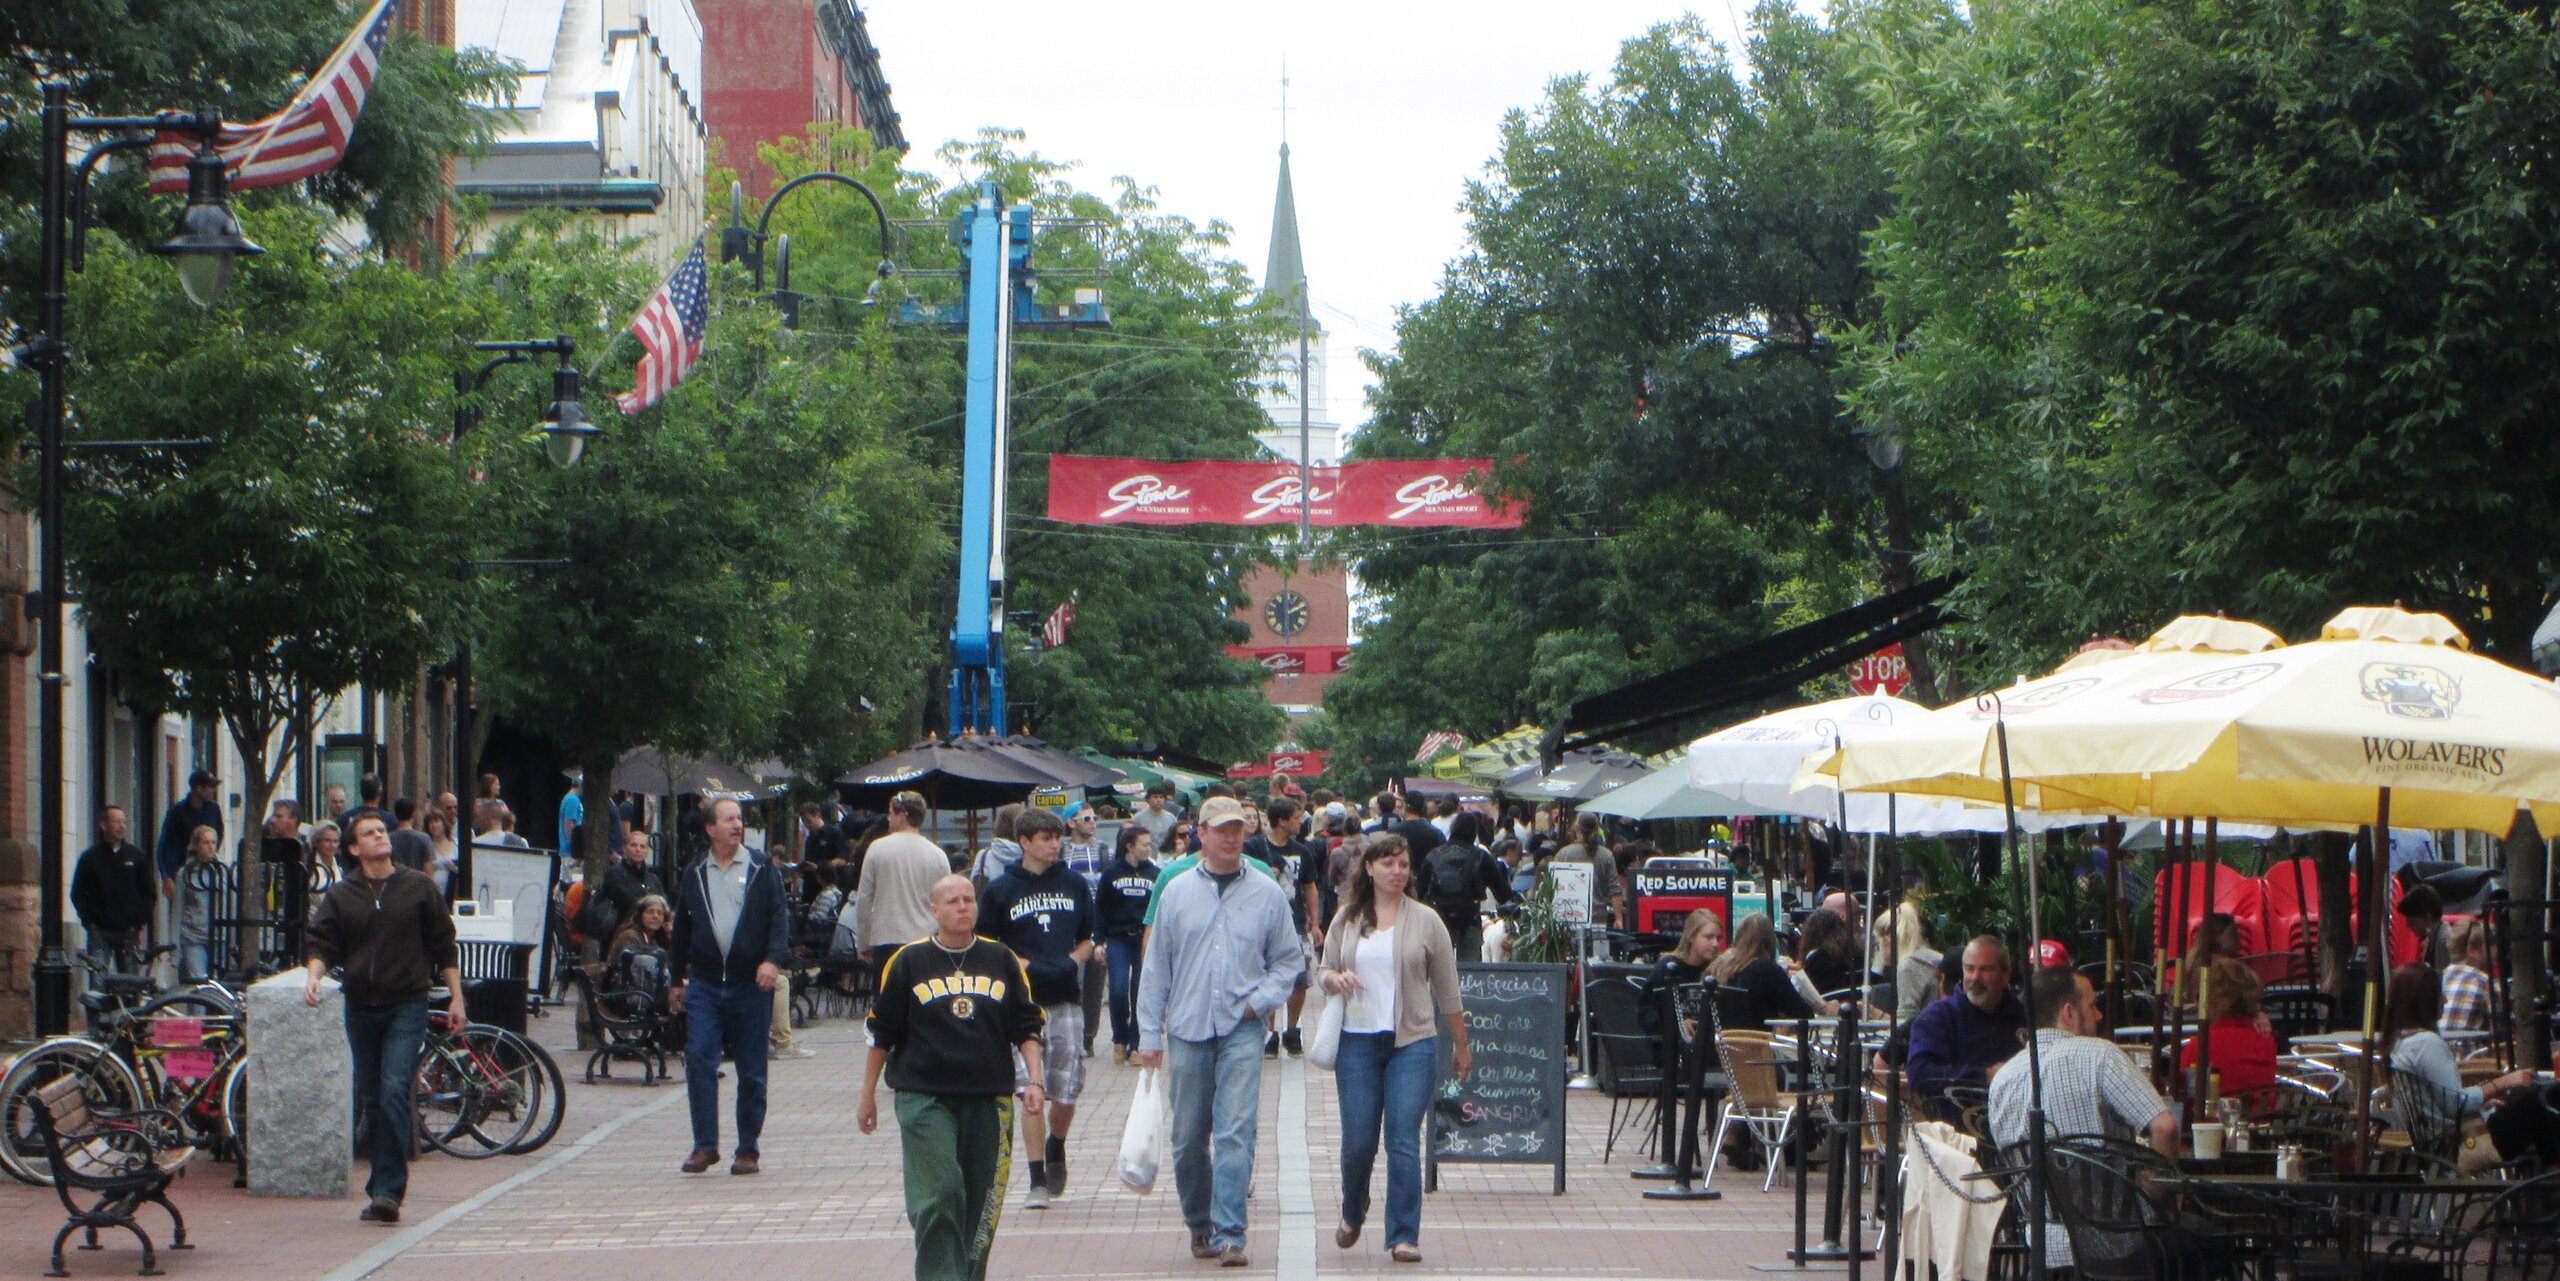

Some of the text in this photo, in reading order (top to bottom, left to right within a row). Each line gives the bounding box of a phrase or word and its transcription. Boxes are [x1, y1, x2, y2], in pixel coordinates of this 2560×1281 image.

[1100, 475, 1190, 517] Stowe
[1846, 655, 1906, 681] STOP
[2361, 736, 2506, 776] WOLAVER'S
[2375, 763, 2400, 773] FINE
[2404, 763, 2457, 775] ORGANIC
[1636, 874, 1726, 896] RED SQUARE
[1010, 898, 1075, 921] CHARLESTON
[1463, 1010, 1503, 1031] Cool
[1461, 1102, 1540, 1122] SANGRIA
